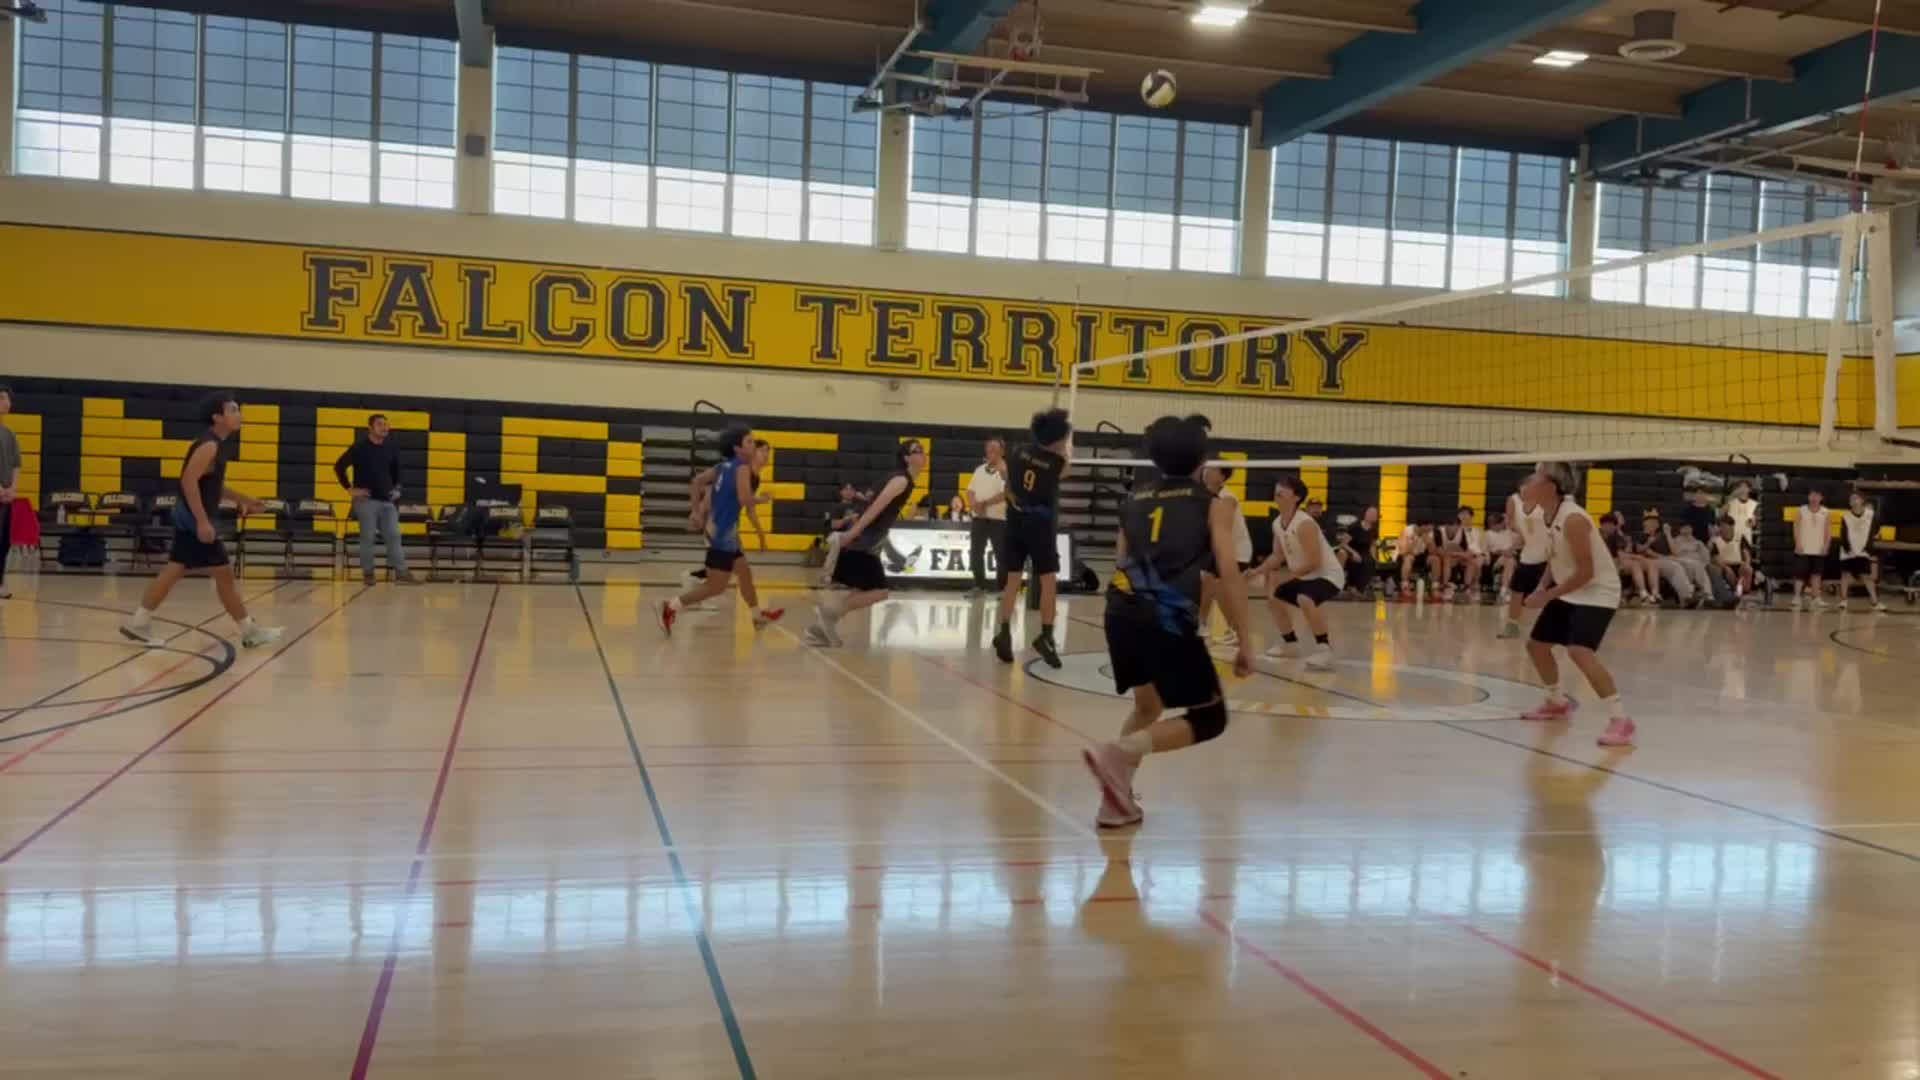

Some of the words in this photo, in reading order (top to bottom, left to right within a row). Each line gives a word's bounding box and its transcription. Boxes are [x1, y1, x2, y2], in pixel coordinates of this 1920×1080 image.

[301, 251, 757, 360] FALCON
[795, 288, 1368, 395] TERRITORY
[1024, 469, 1038, 491] 9
[1147, 505, 1164, 543] 1
